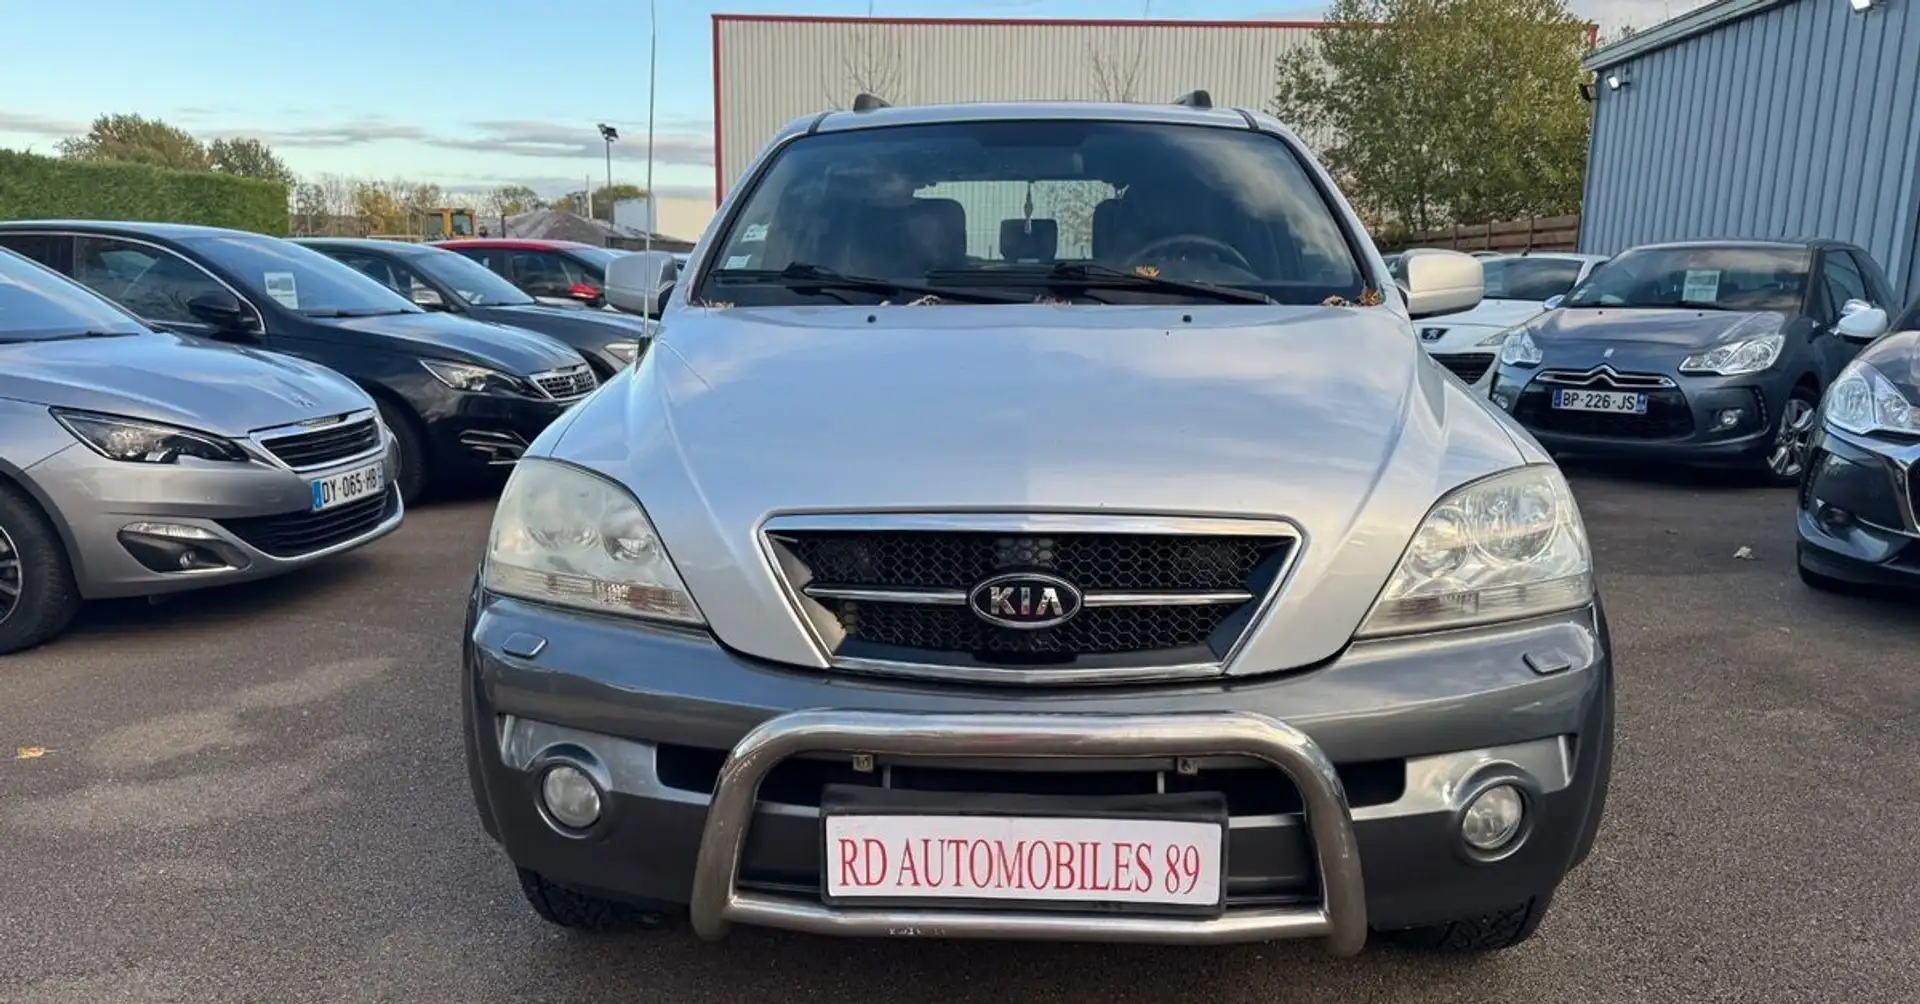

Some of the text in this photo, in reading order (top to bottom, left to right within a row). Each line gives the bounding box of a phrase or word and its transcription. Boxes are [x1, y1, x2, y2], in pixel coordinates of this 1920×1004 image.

[1563, 392, 1635, 410] BP-226-JS
[989, 586, 1063, 615] KIA
[838, 837, 1200, 895] RD AUTOMOBILES 89
